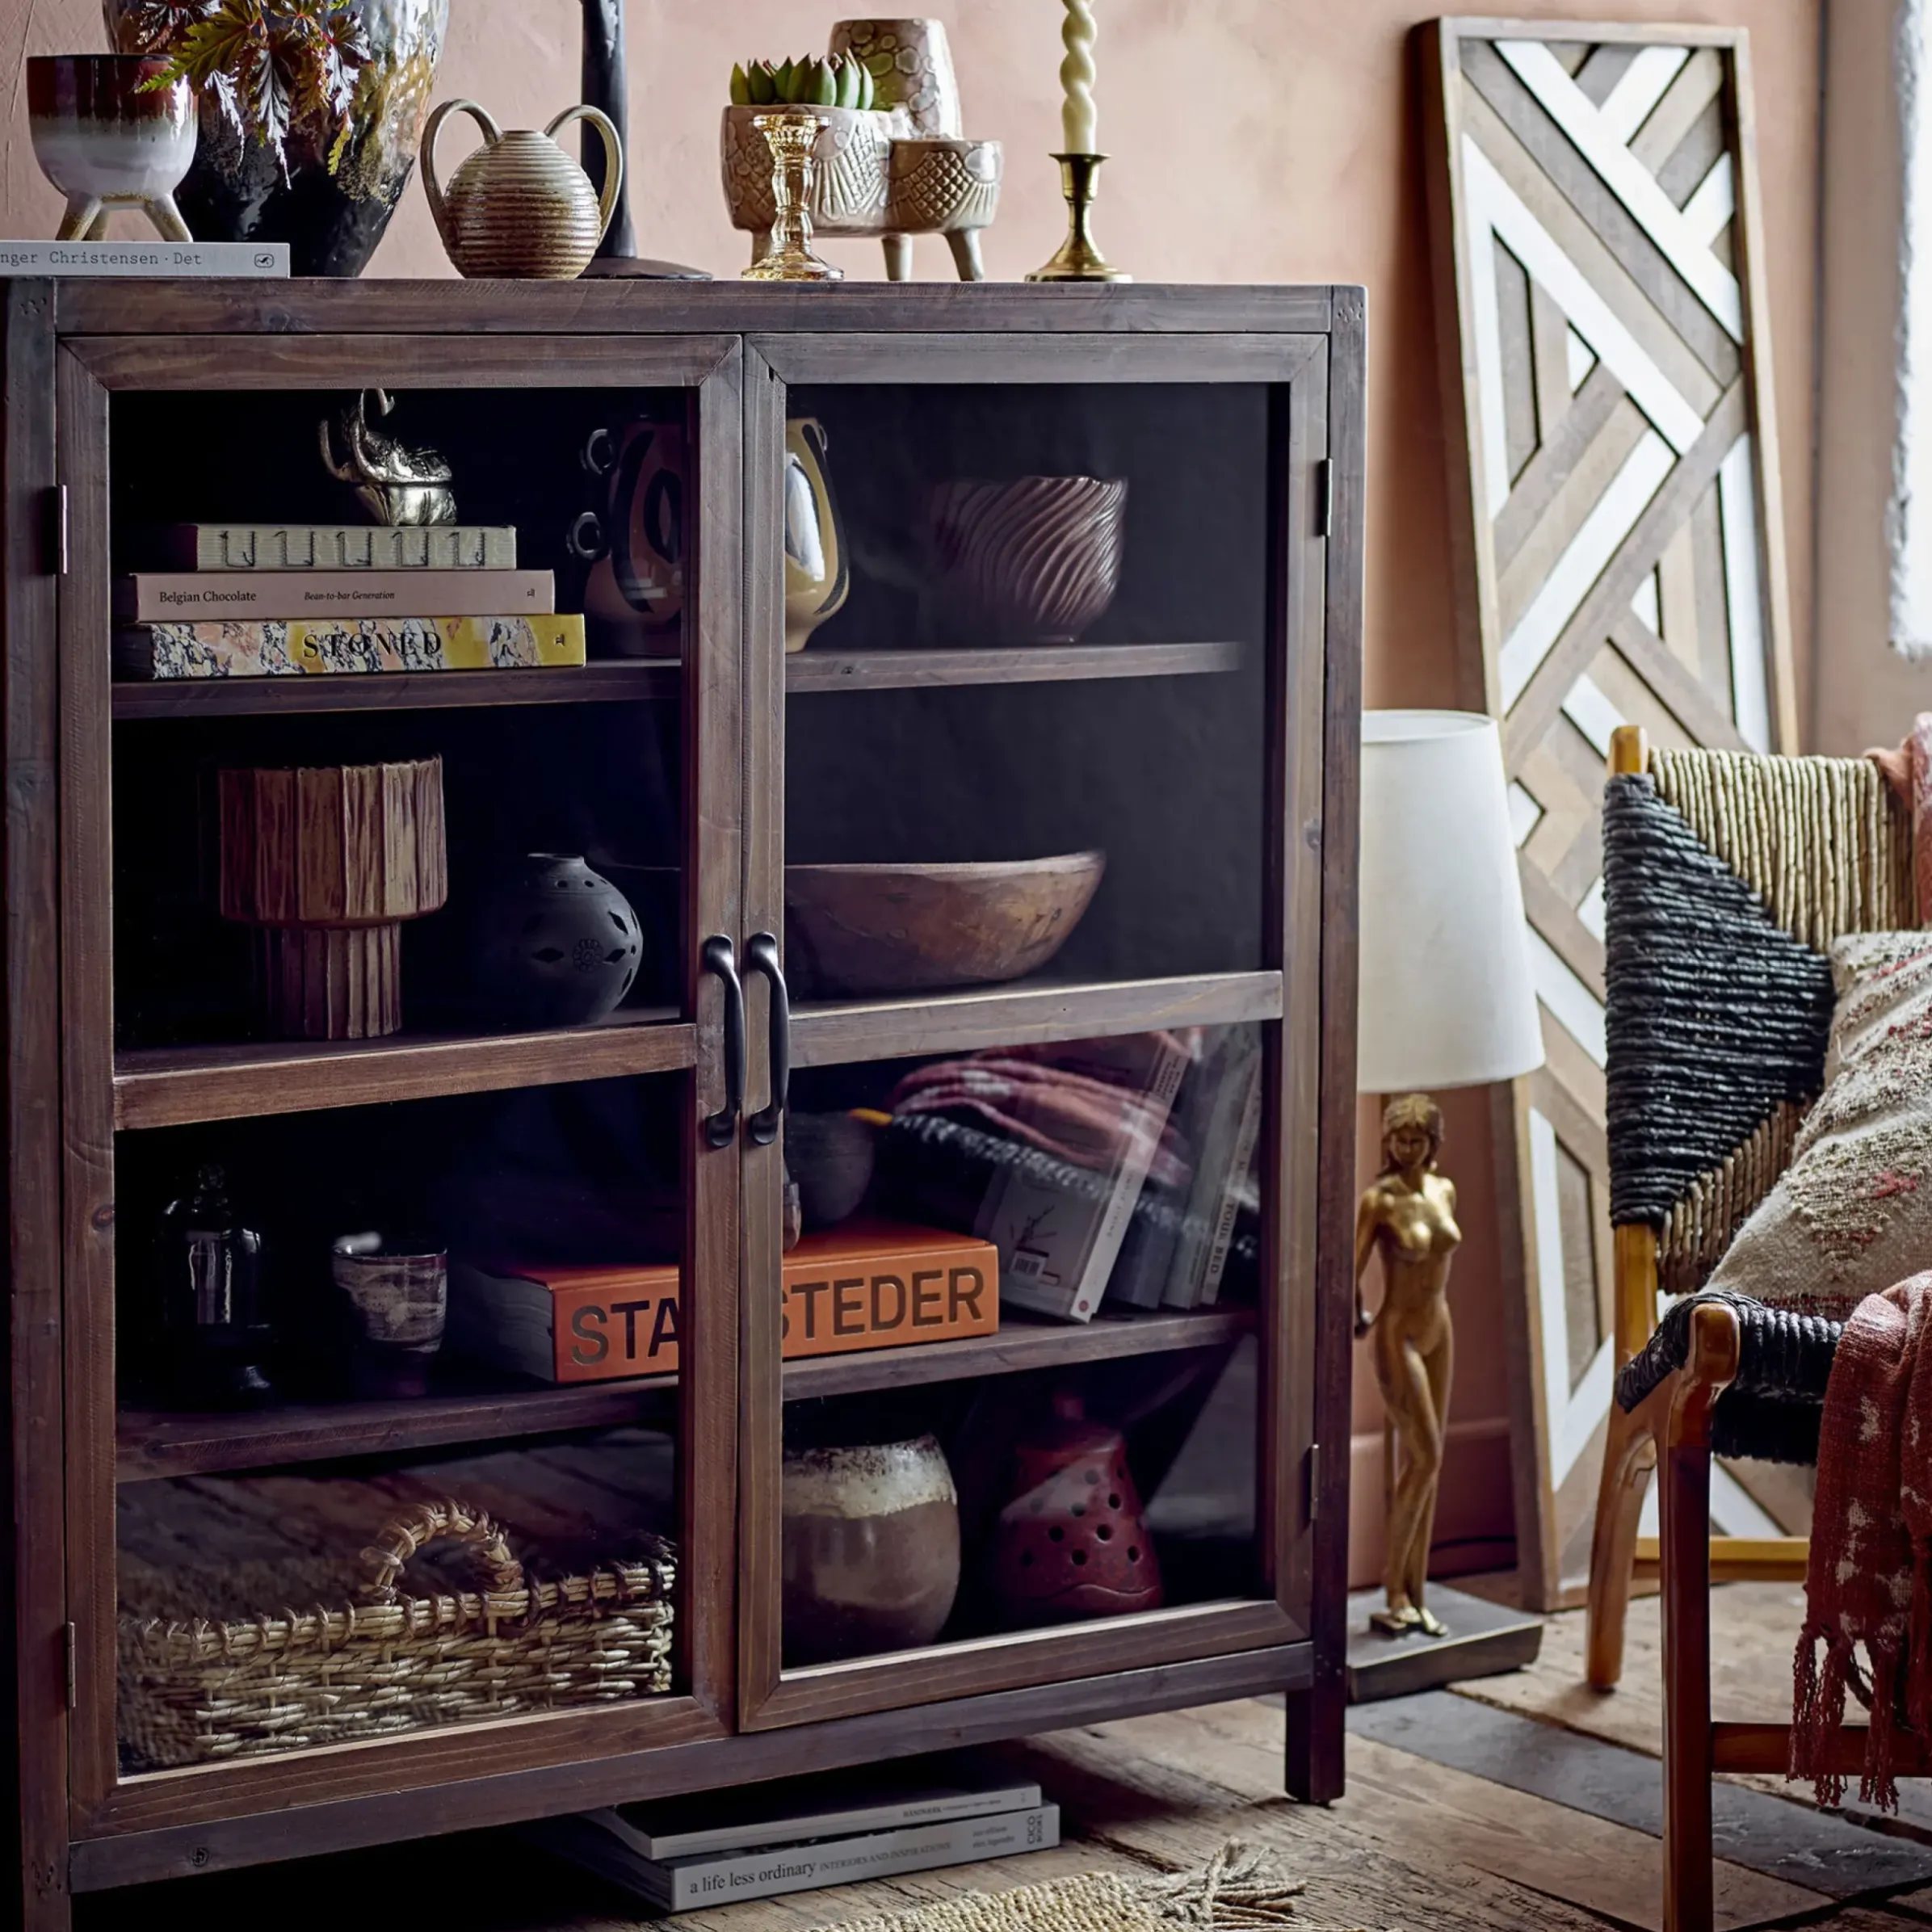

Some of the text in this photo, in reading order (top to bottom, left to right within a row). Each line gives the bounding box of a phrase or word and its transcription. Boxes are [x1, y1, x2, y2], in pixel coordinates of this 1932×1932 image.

[49, 250, 159, 264] Christensen
[174, 251, 202, 265] Det
[159, 590, 257, 605] Belgian Chocolate
[304, 590, 395, 601] Bean-to-bar Generation
[303, 631, 442, 657] STONED
[782, 1266, 985, 1341] TEDER
[1027, 1816, 1035, 1844] CICO
[689, 1882, 699, 1894] a
[702, 1874, 726, 1892] life
[729, 1872, 755, 1887] less
[758, 1861, 817, 1883] ordinary
